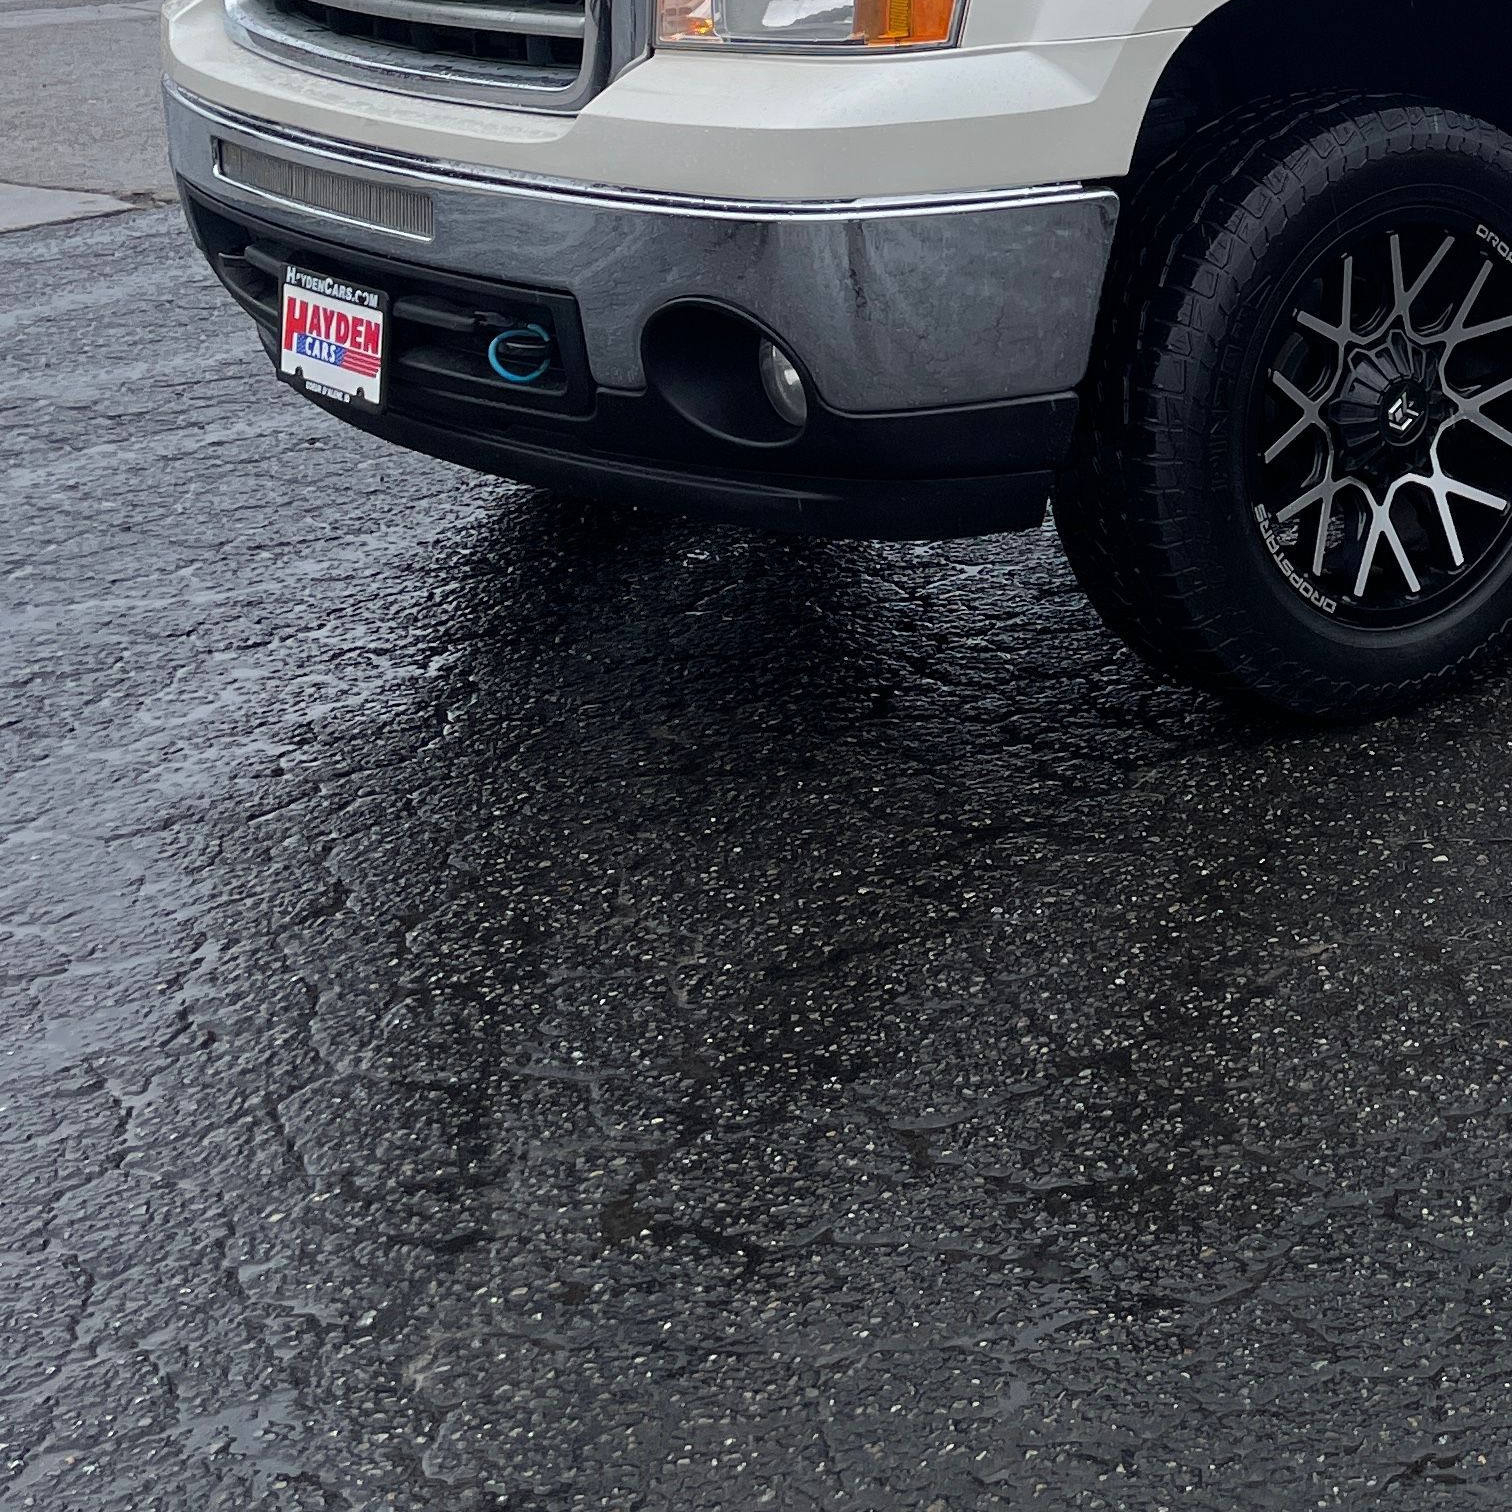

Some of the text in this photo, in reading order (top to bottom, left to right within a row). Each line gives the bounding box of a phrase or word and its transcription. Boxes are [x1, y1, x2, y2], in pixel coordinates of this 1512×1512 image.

[284, 296, 381, 355] HAYDEN
[305, 337, 337, 363] CARS
[1254, 504, 1337, 614] DROPSTARS
